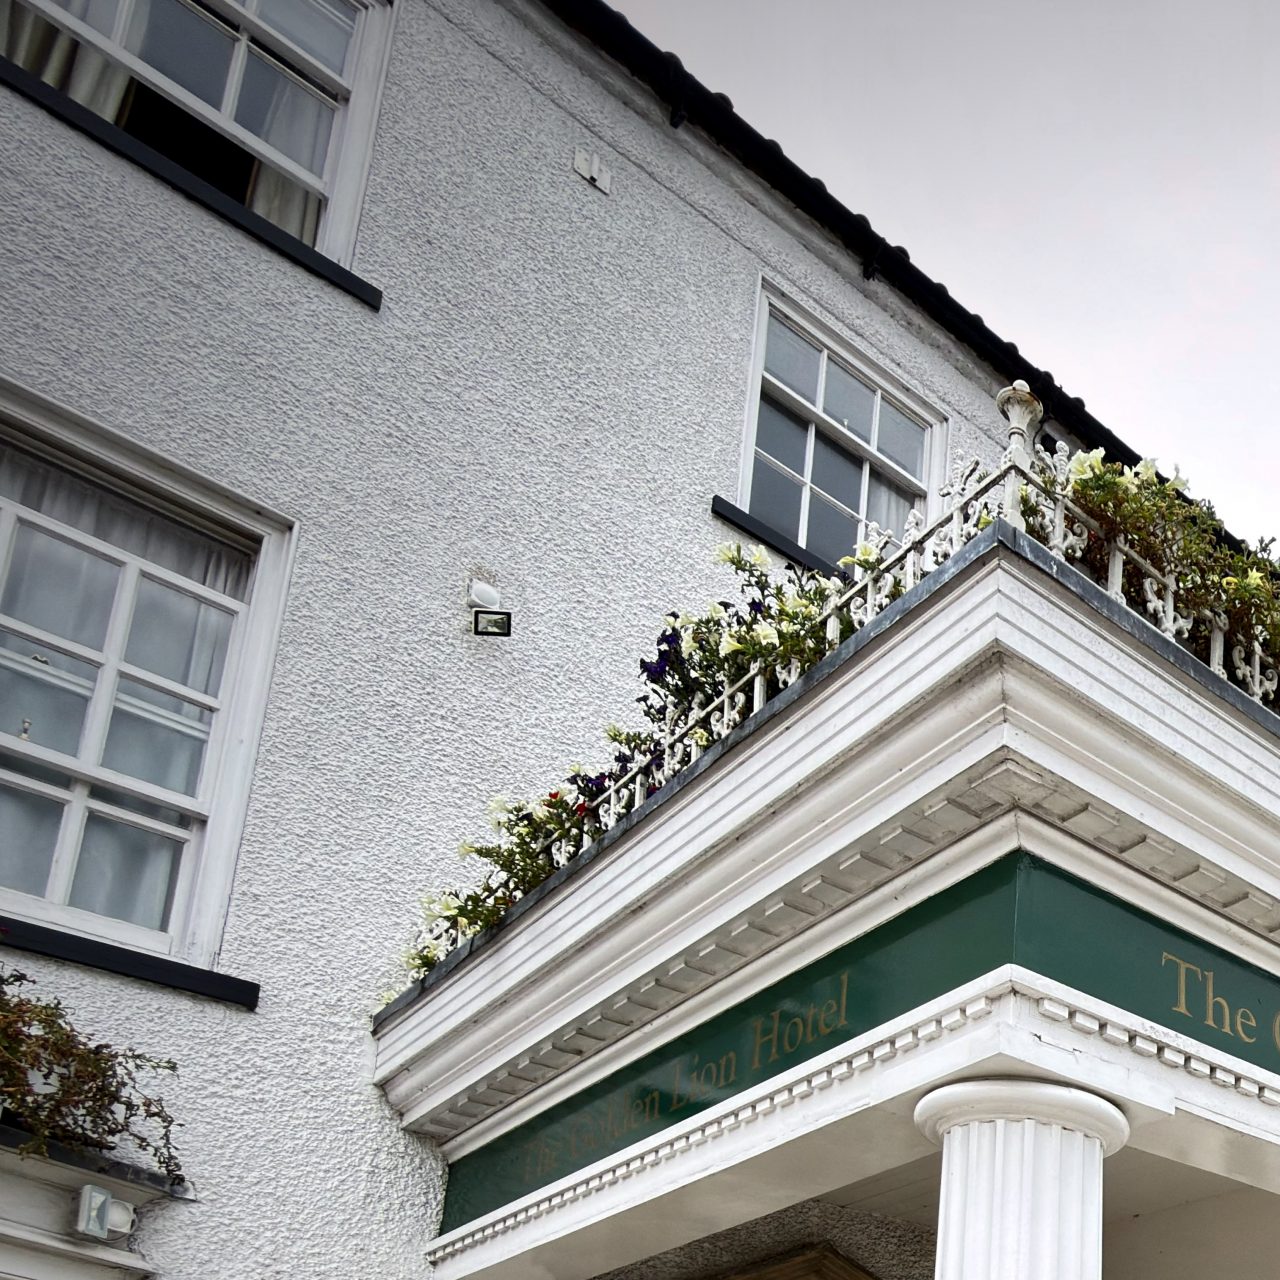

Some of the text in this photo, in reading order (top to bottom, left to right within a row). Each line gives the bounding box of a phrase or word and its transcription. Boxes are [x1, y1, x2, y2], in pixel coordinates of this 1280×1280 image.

[670, 1049, 738, 1111] Lion
[752, 970, 849, 1071] Hotel
[1161, 951, 1258, 1044] The
